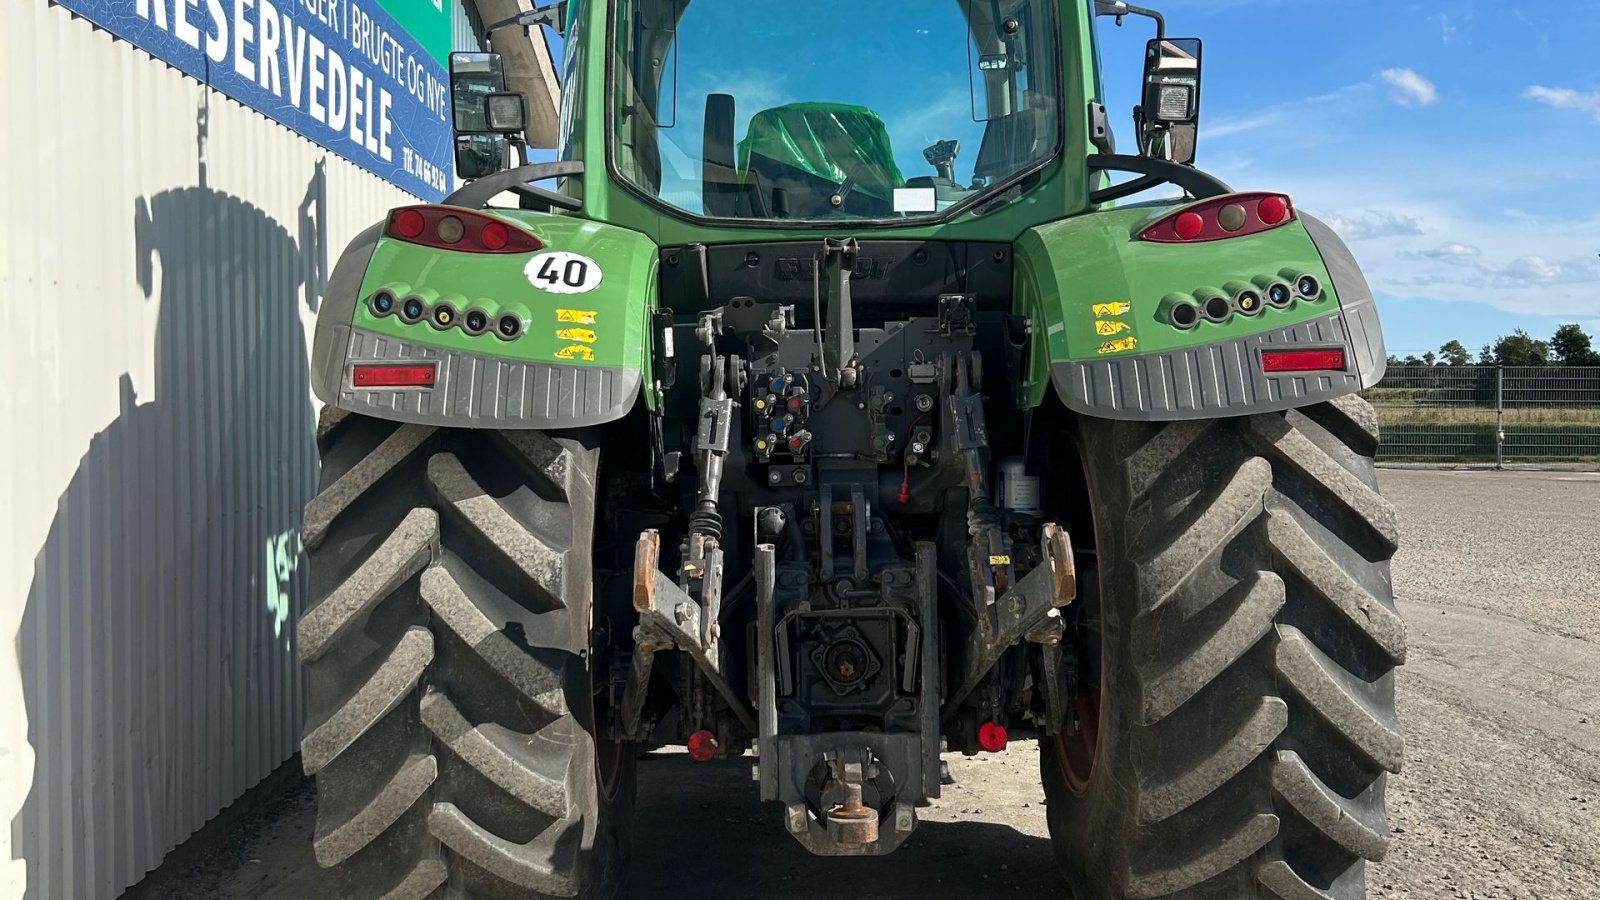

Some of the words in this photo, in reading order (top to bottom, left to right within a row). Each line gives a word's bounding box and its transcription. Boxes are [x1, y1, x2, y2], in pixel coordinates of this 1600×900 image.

[136, 0, 392, 162] ESERVEDELE
[352, 3, 404, 87] BRUGTE
[407, 55, 424, 103] OG
[427, 72, 446, 122] NYE
[537, 257, 588, 288] 40
